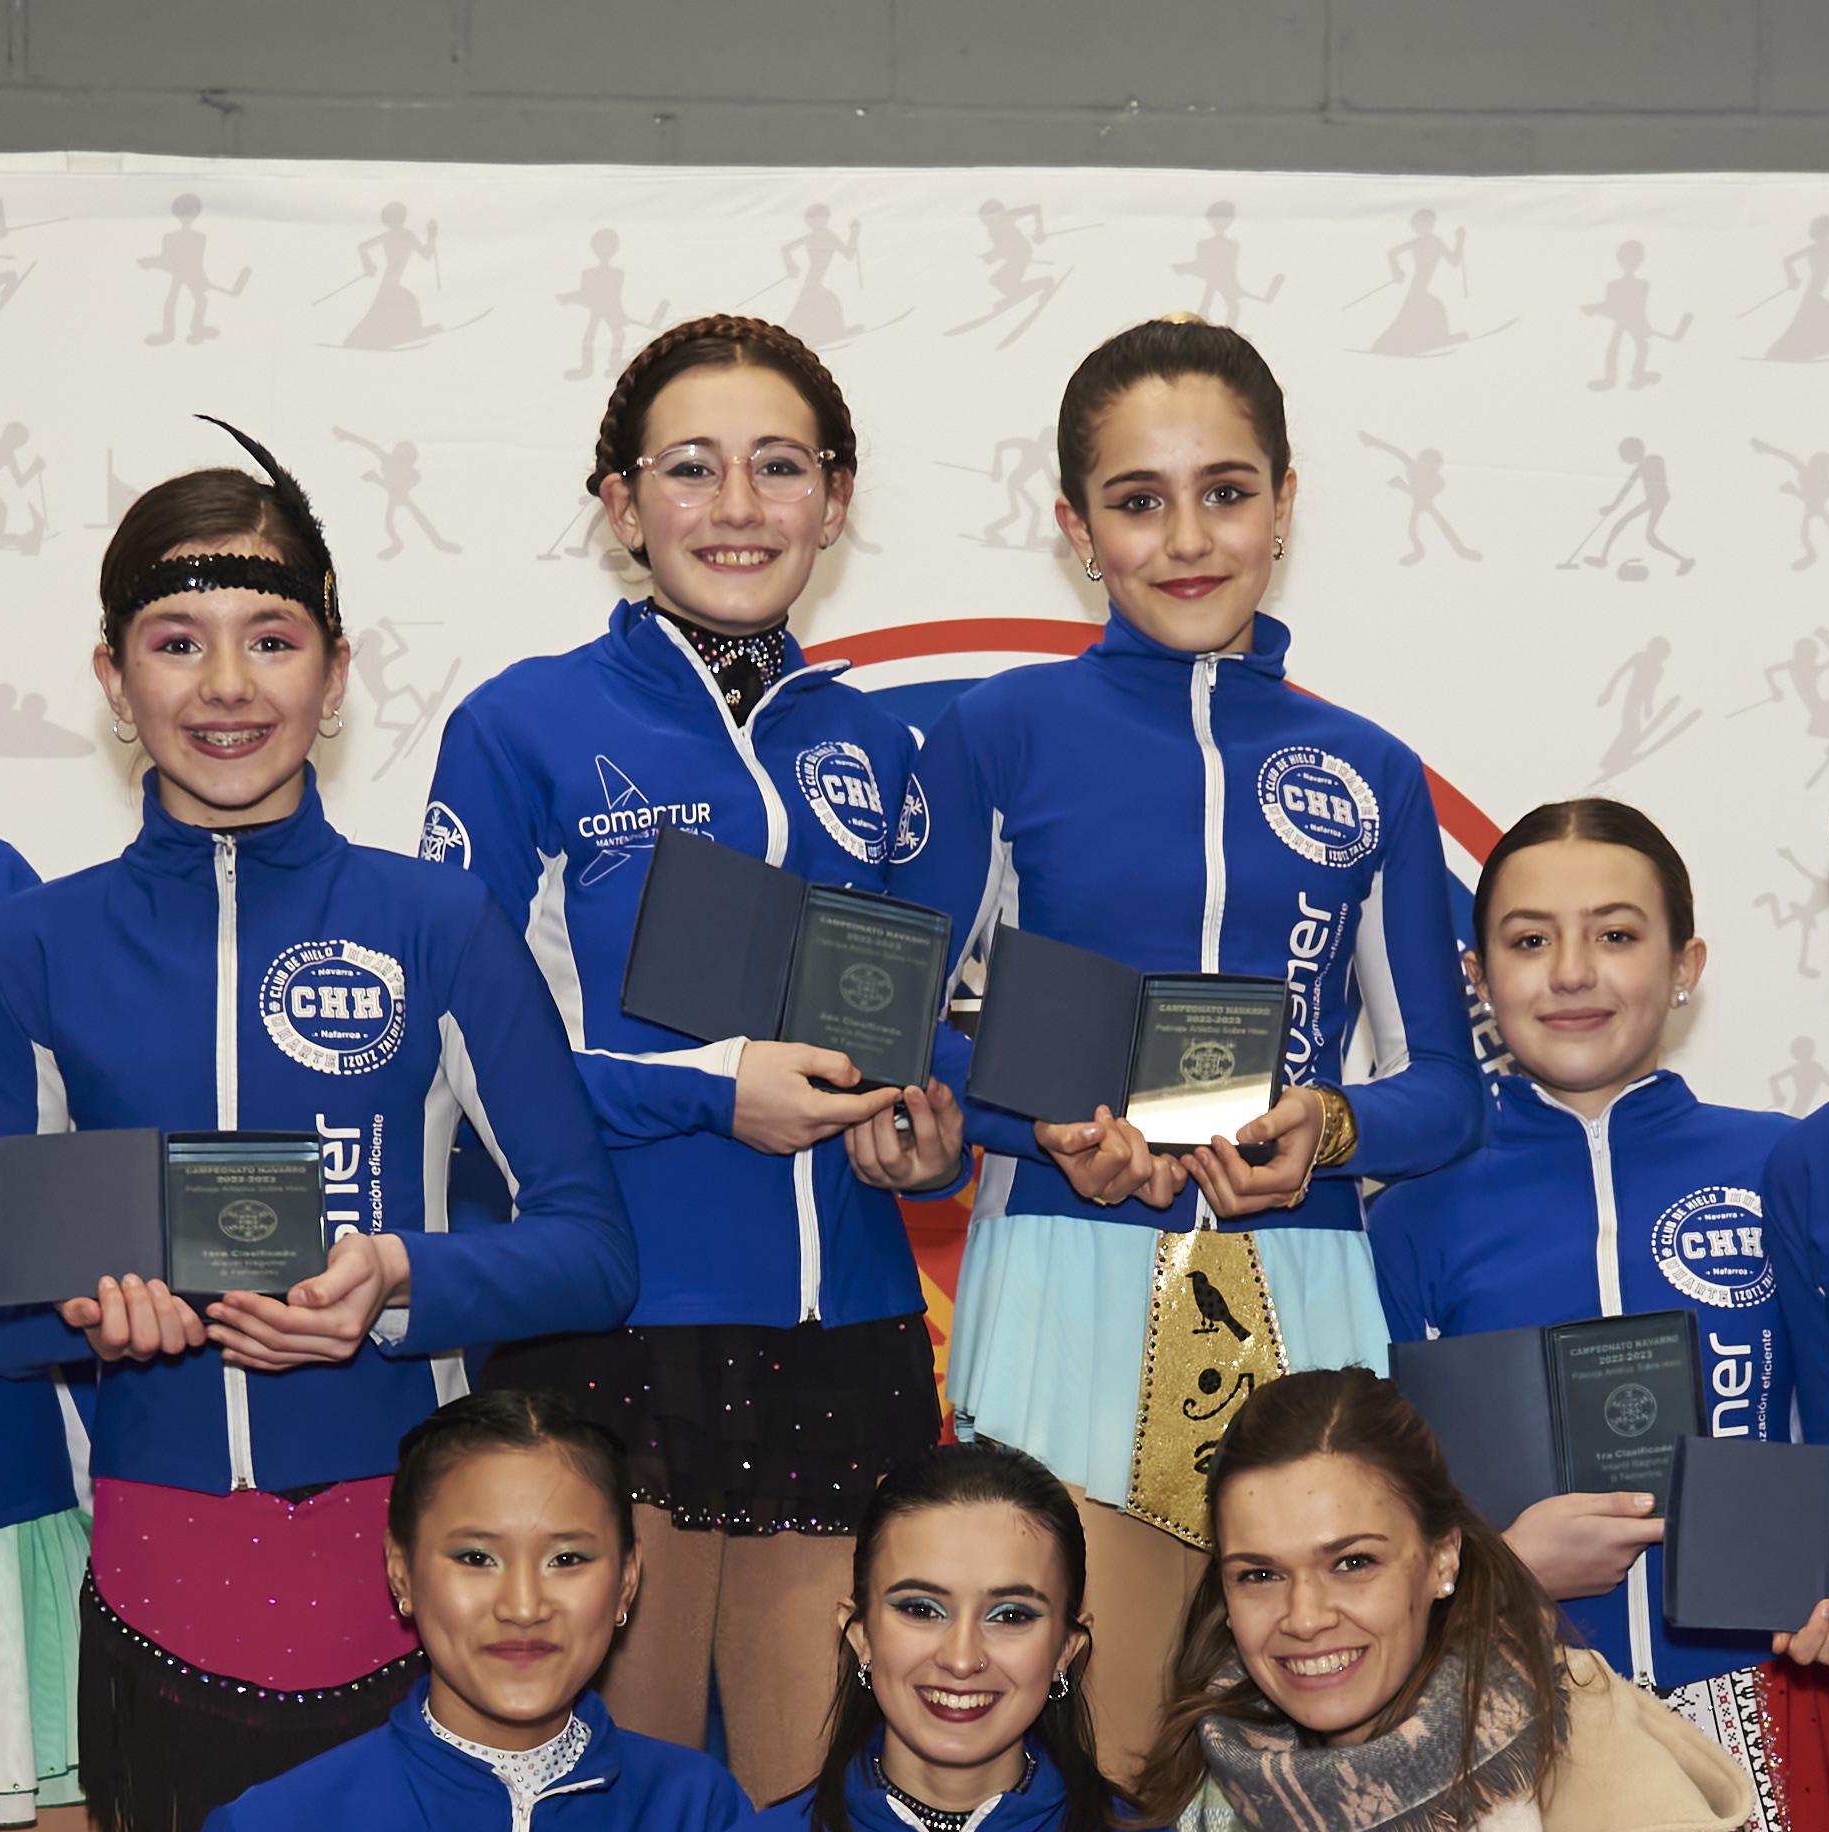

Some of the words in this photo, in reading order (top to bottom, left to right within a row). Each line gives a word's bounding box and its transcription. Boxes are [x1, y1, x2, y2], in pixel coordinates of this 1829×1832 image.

[1283, 784, 1355, 827] CHH
[269, 970, 289, 998] CLUB
[284, 956, 300, 971] DE
[300, 947, 333, 963] HIELO
[291, 986, 383, 1019] CHH
[321, 1030, 361, 1039] Nafarroa
[343, 1050, 378, 1068] IZOTZ
[378, 1016, 402, 1054] TALDEA
[368, 1114, 384, 1176] eficiente
[1661, 1221, 1677, 1245] CLUB
[1671, 1208, 1687, 1221] DE
[1685, 1194, 1717, 1210] HIELO
[1681, 1227, 1763, 1259] CHH
[1735, 1285, 1764, 1301] IZOTZ
[1761, 1329, 1773, 1389] eficiente
[1709, 1332, 1752, 1438] ner
